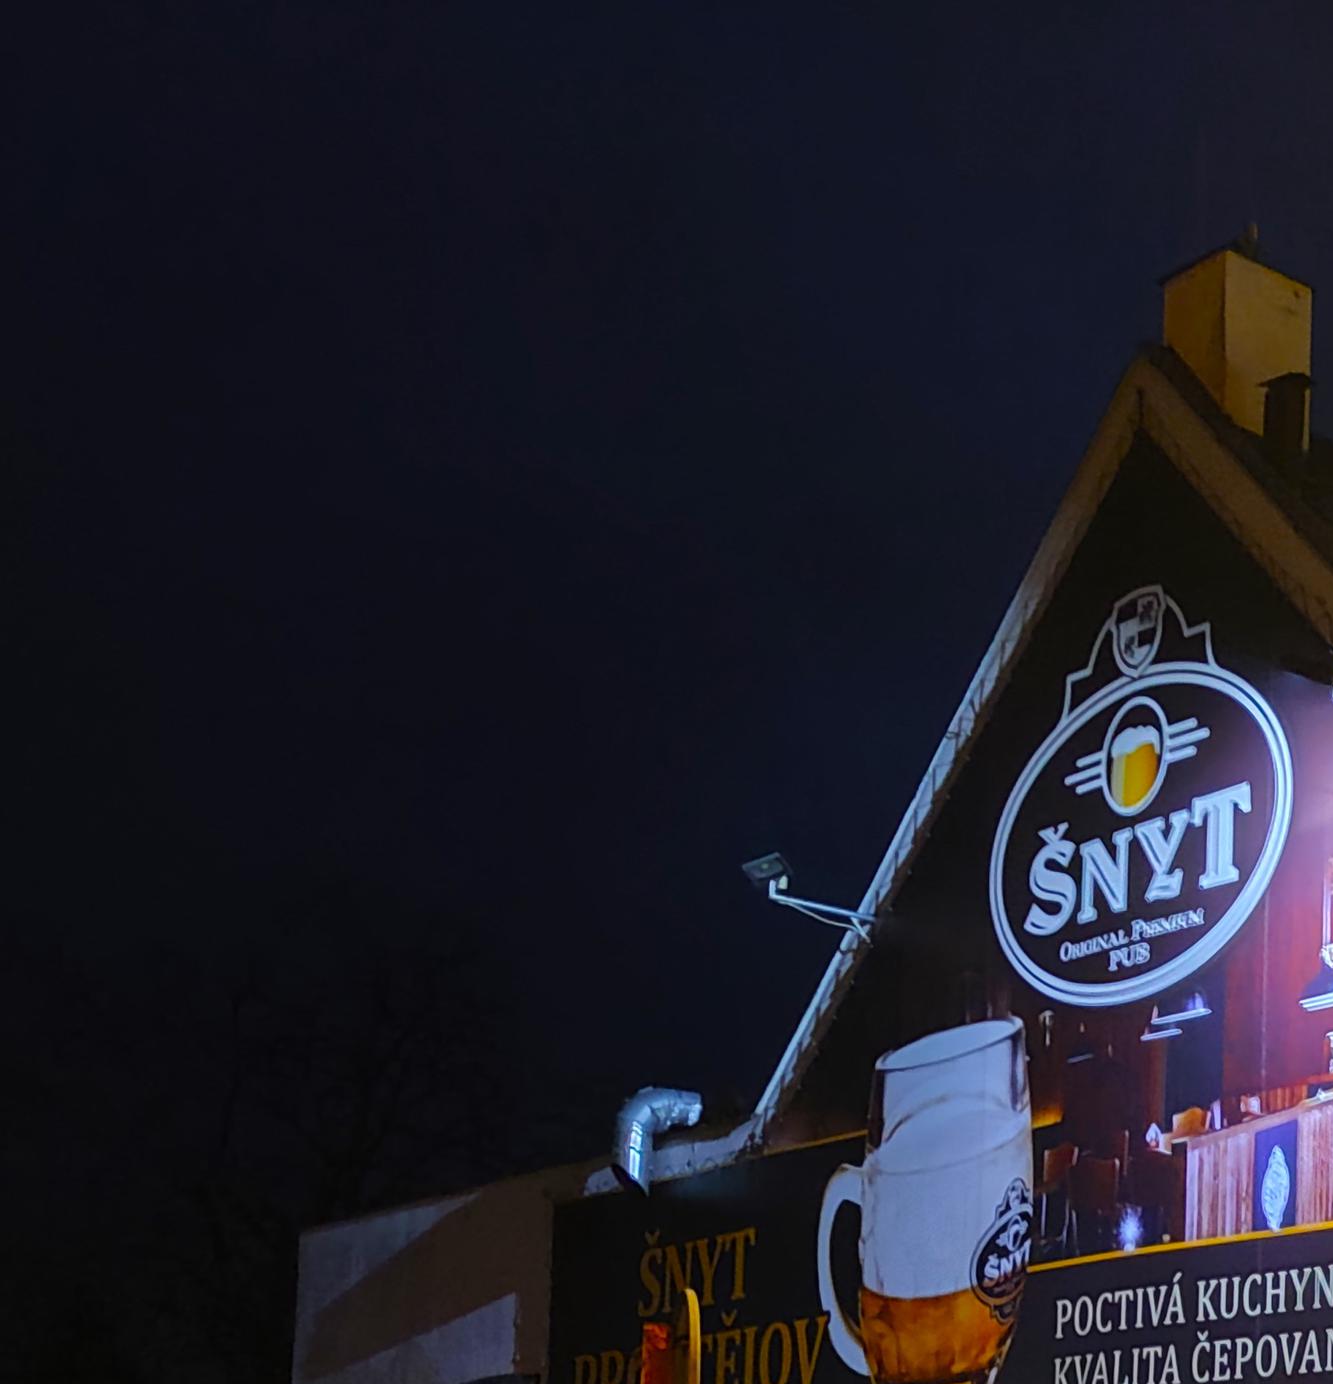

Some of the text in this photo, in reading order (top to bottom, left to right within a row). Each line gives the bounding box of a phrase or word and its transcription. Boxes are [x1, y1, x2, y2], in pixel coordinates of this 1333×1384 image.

[1023, 781, 1252, 936] ŠNYT
[637, 1227, 757, 1318] ŠNYT
[1054, 1271, 1186, 1340] POCTIVÁ
